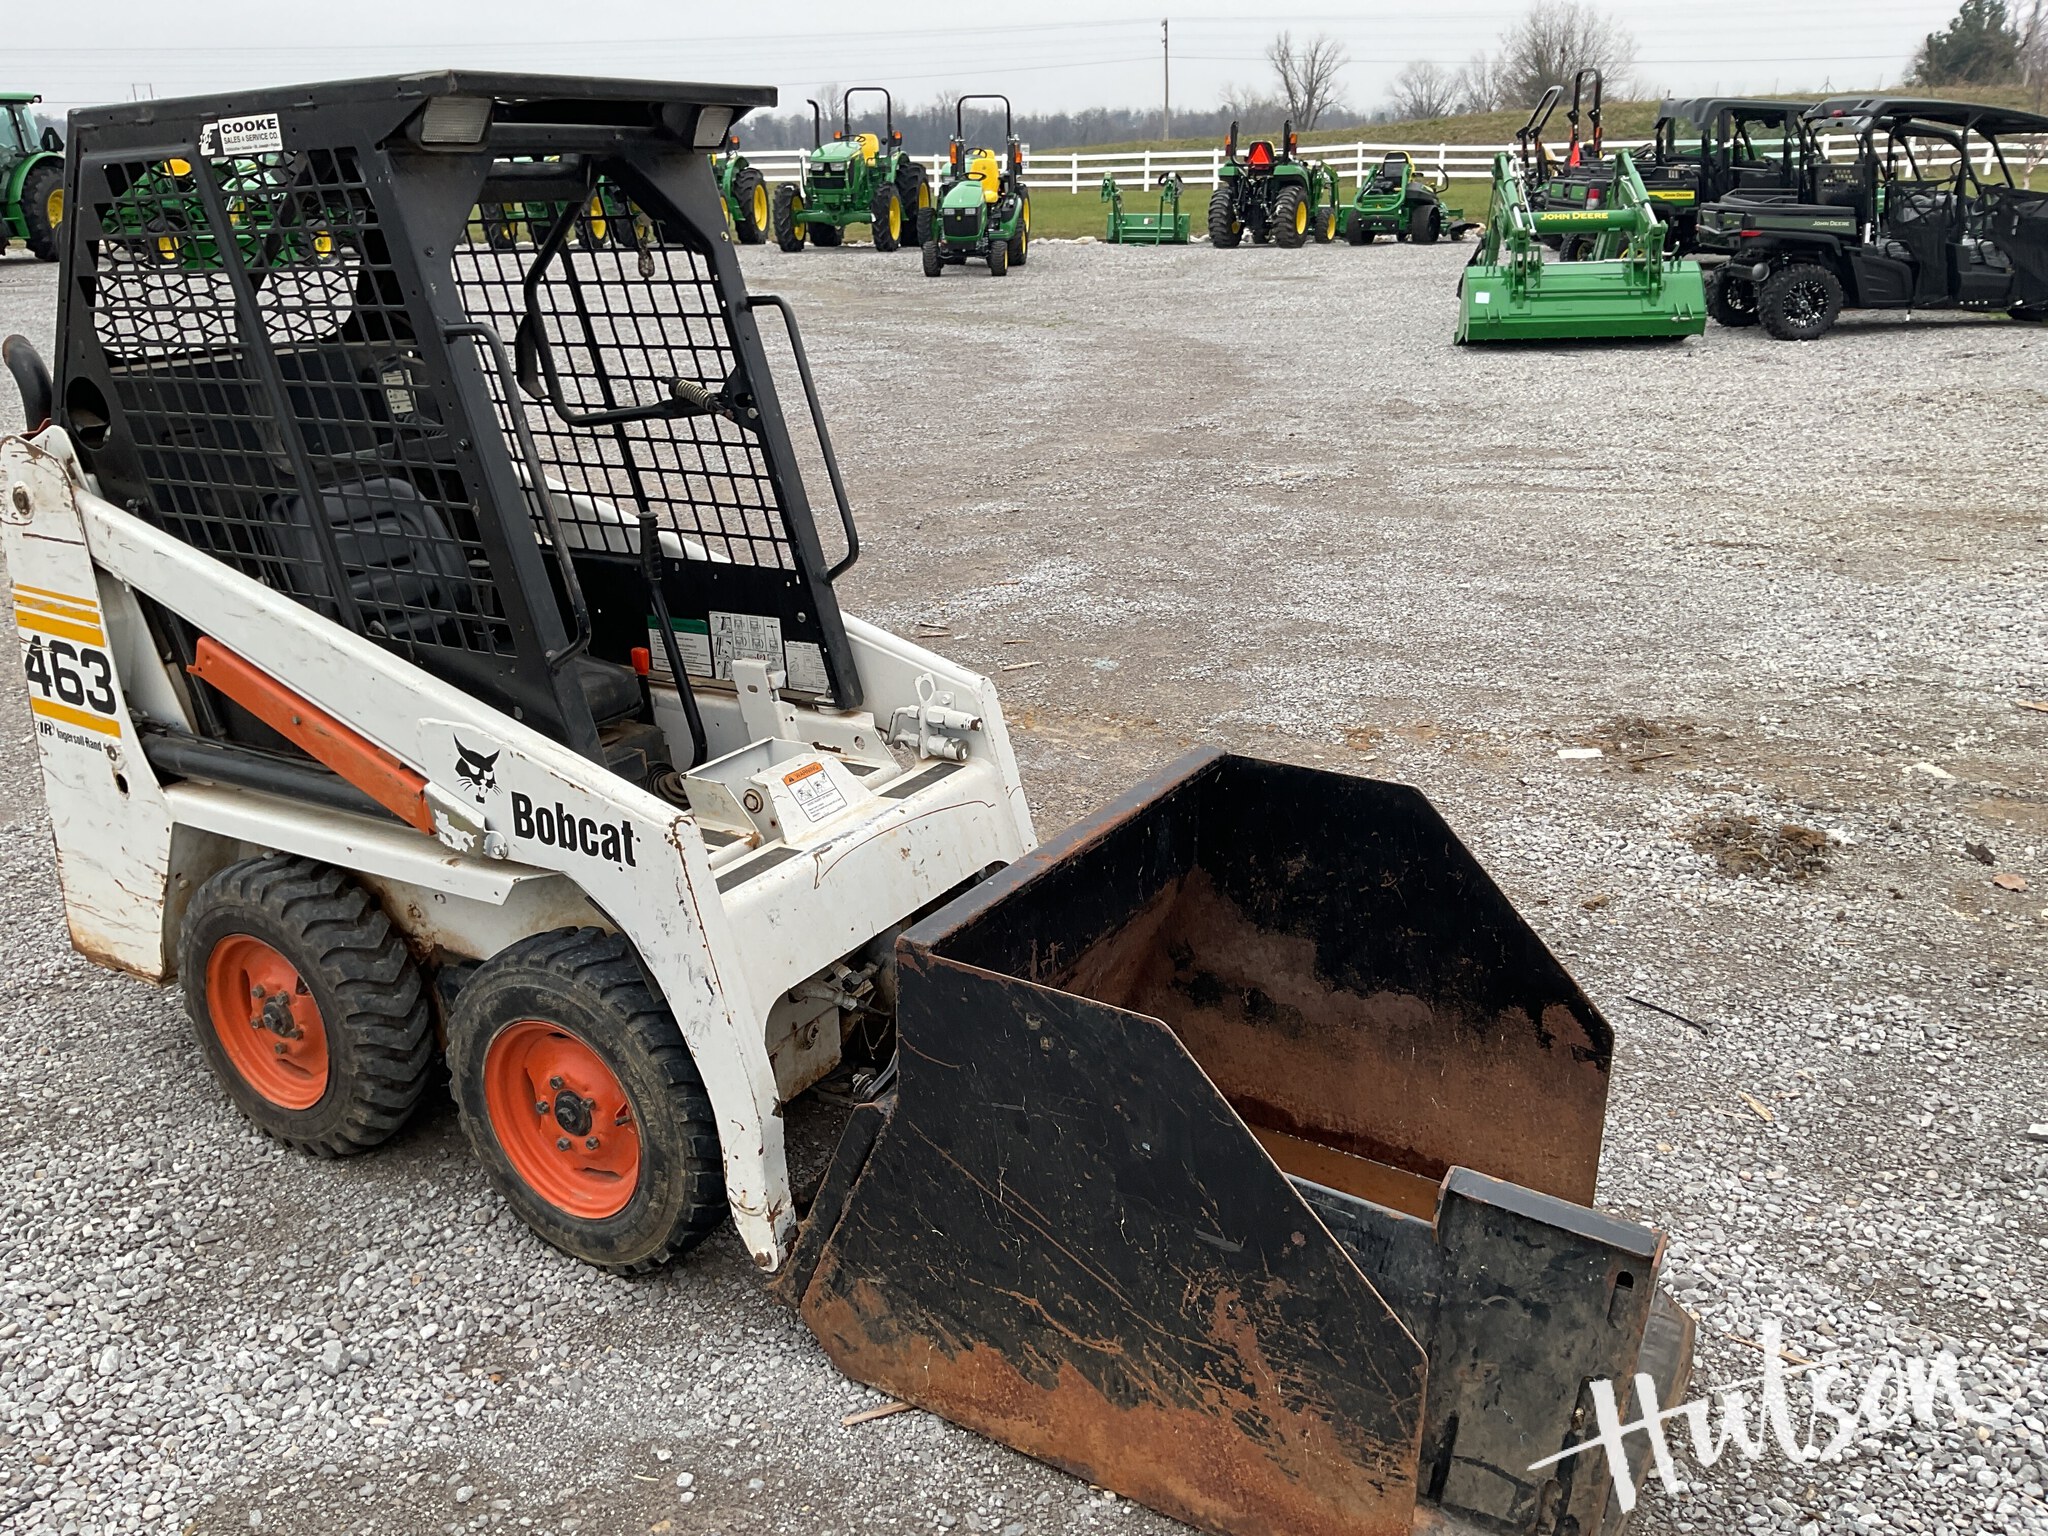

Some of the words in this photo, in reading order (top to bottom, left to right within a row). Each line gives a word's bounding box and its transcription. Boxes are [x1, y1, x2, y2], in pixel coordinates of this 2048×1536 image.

[222, 118, 277, 134] COOKE
[224, 135, 240, 144] SALES
[246, 133, 268, 142] SERVICE
[1541, 213, 1570, 221] JOHN
[1572, 212, 1609, 220] DEERE
[25, 635, 117, 715] 463
[40, 722, 53, 736] IR
[795, 765, 819, 778] WARNING
[511, 791, 637, 867] Bobcat
